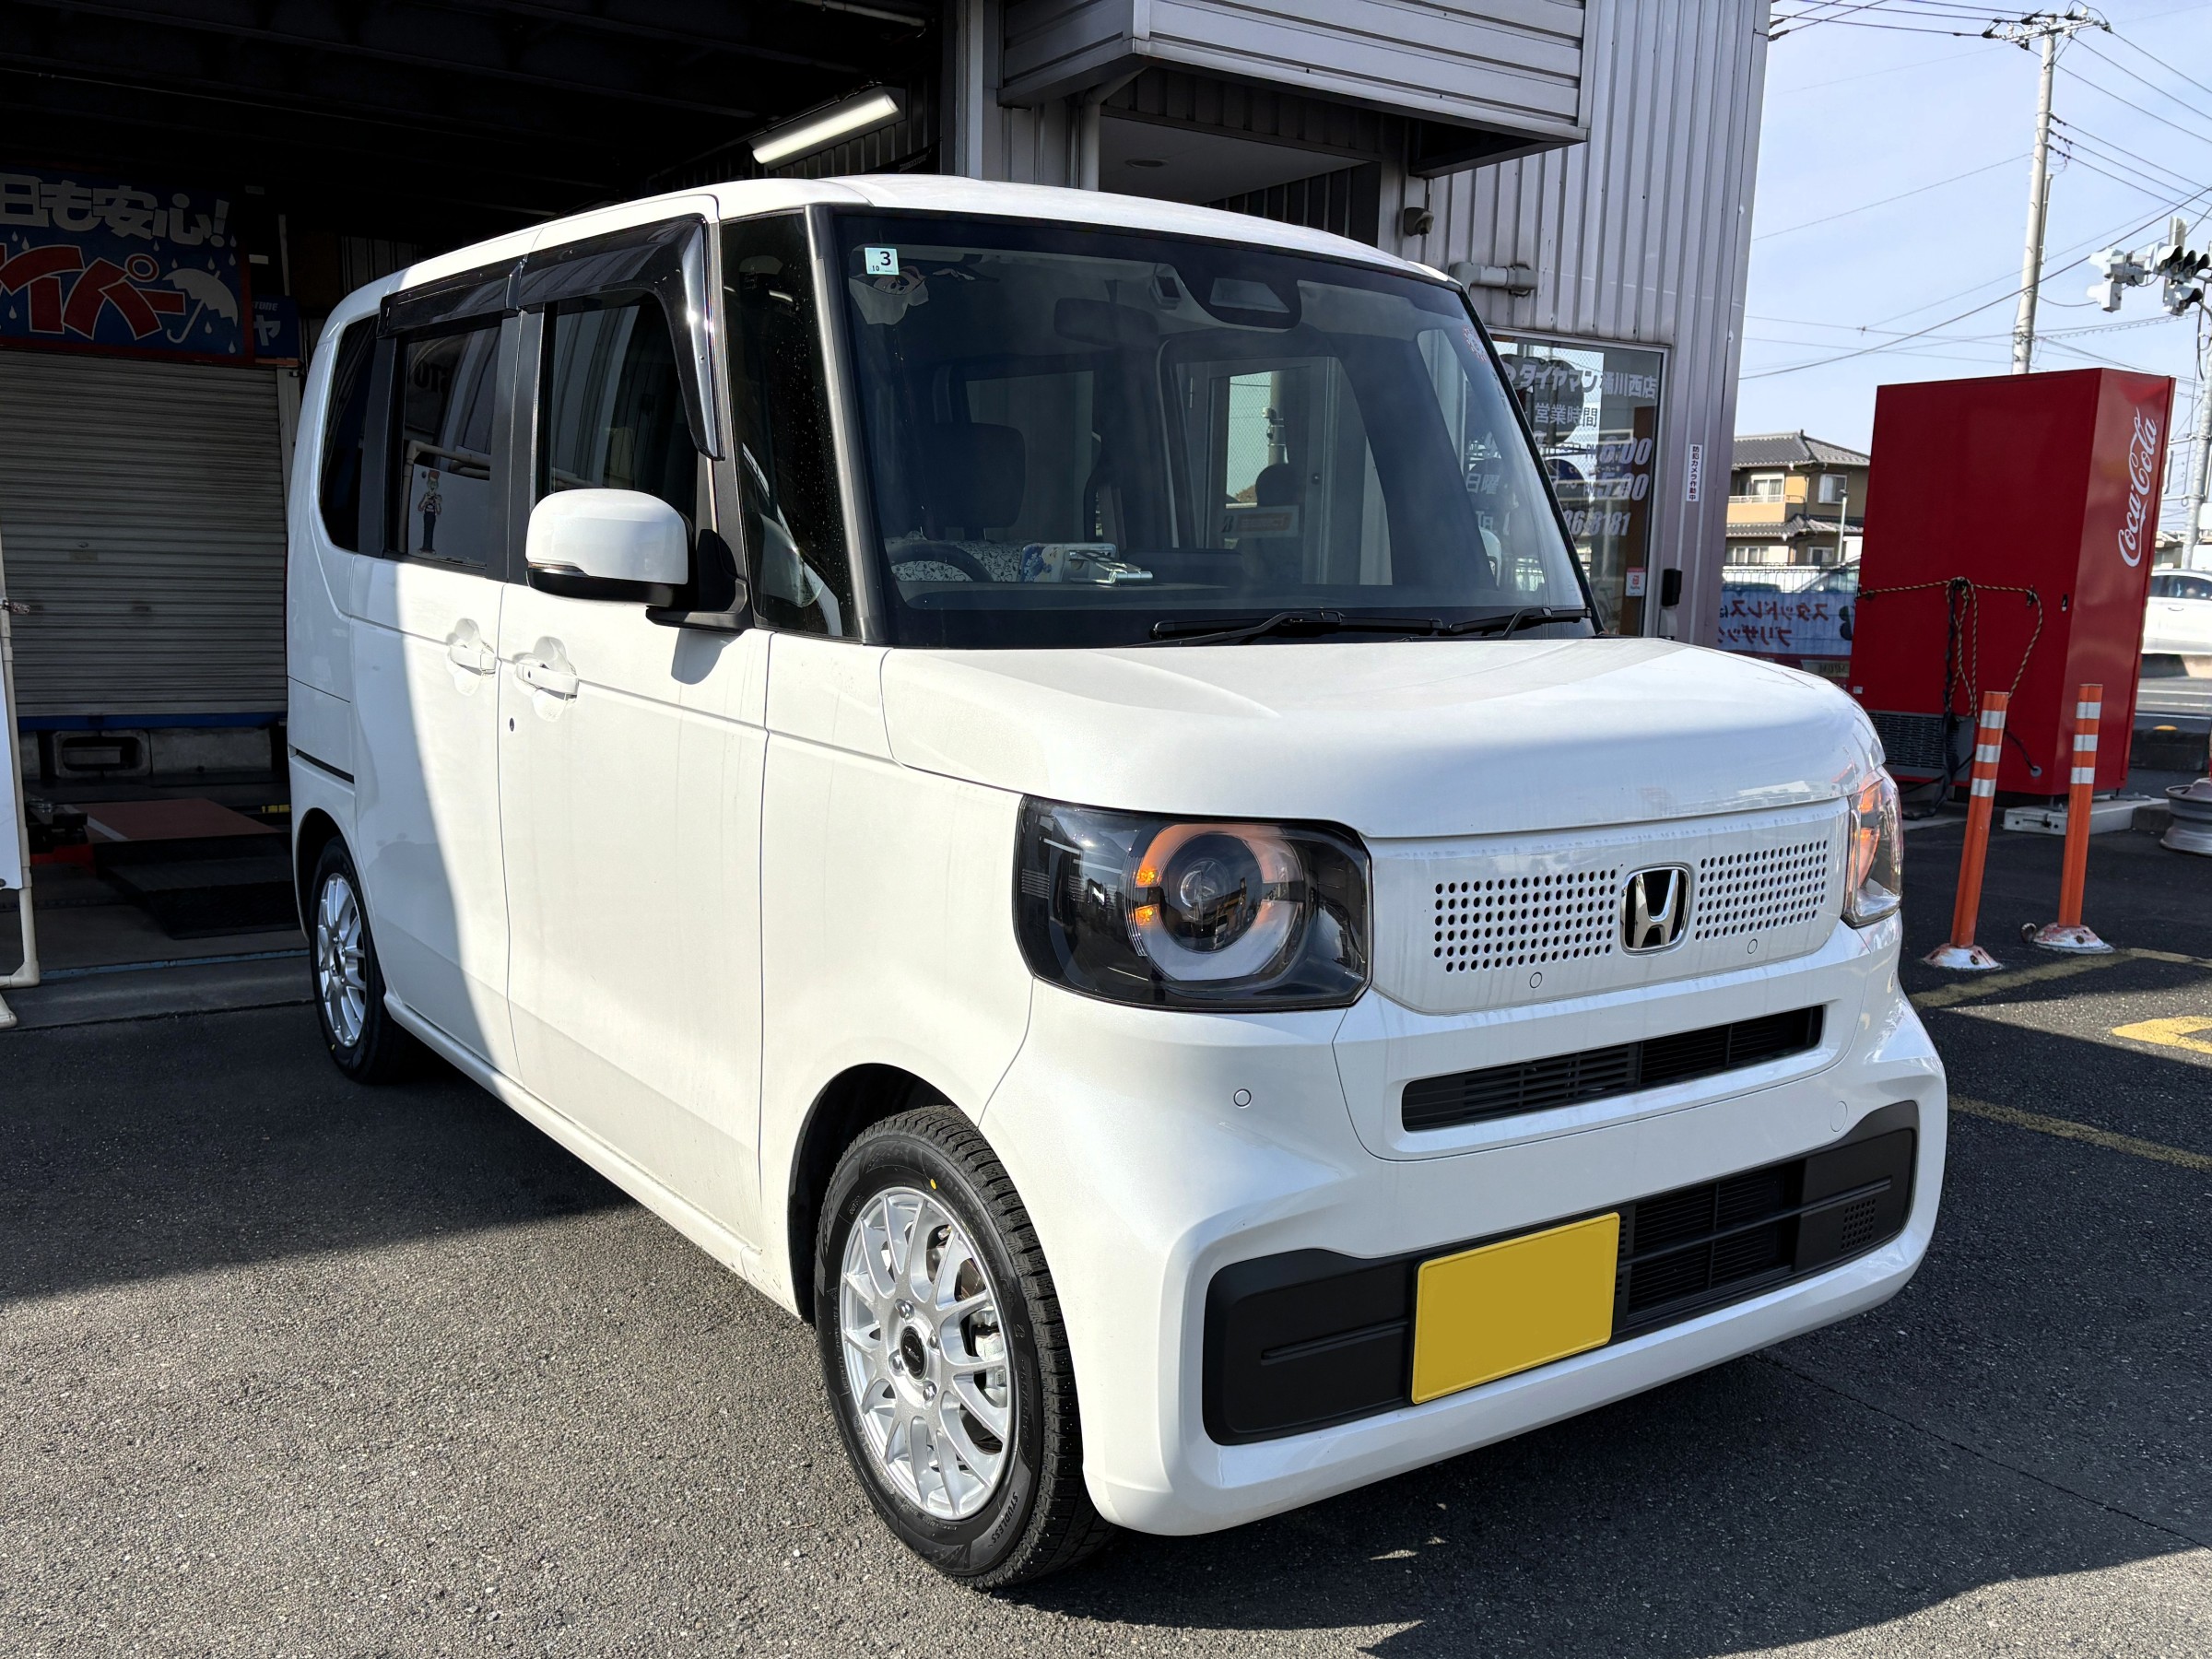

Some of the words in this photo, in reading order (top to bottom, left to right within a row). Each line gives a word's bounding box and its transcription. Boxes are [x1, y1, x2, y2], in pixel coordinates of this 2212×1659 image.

[880, 252, 891, 265] 3
[0, 243, 186, 341] イパー
[1534, 403, 1597, 429] 営業時間
[2118, 406, 2159, 568] Coca-Cola
[991, 1491, 1018, 1544] STUDLESS
